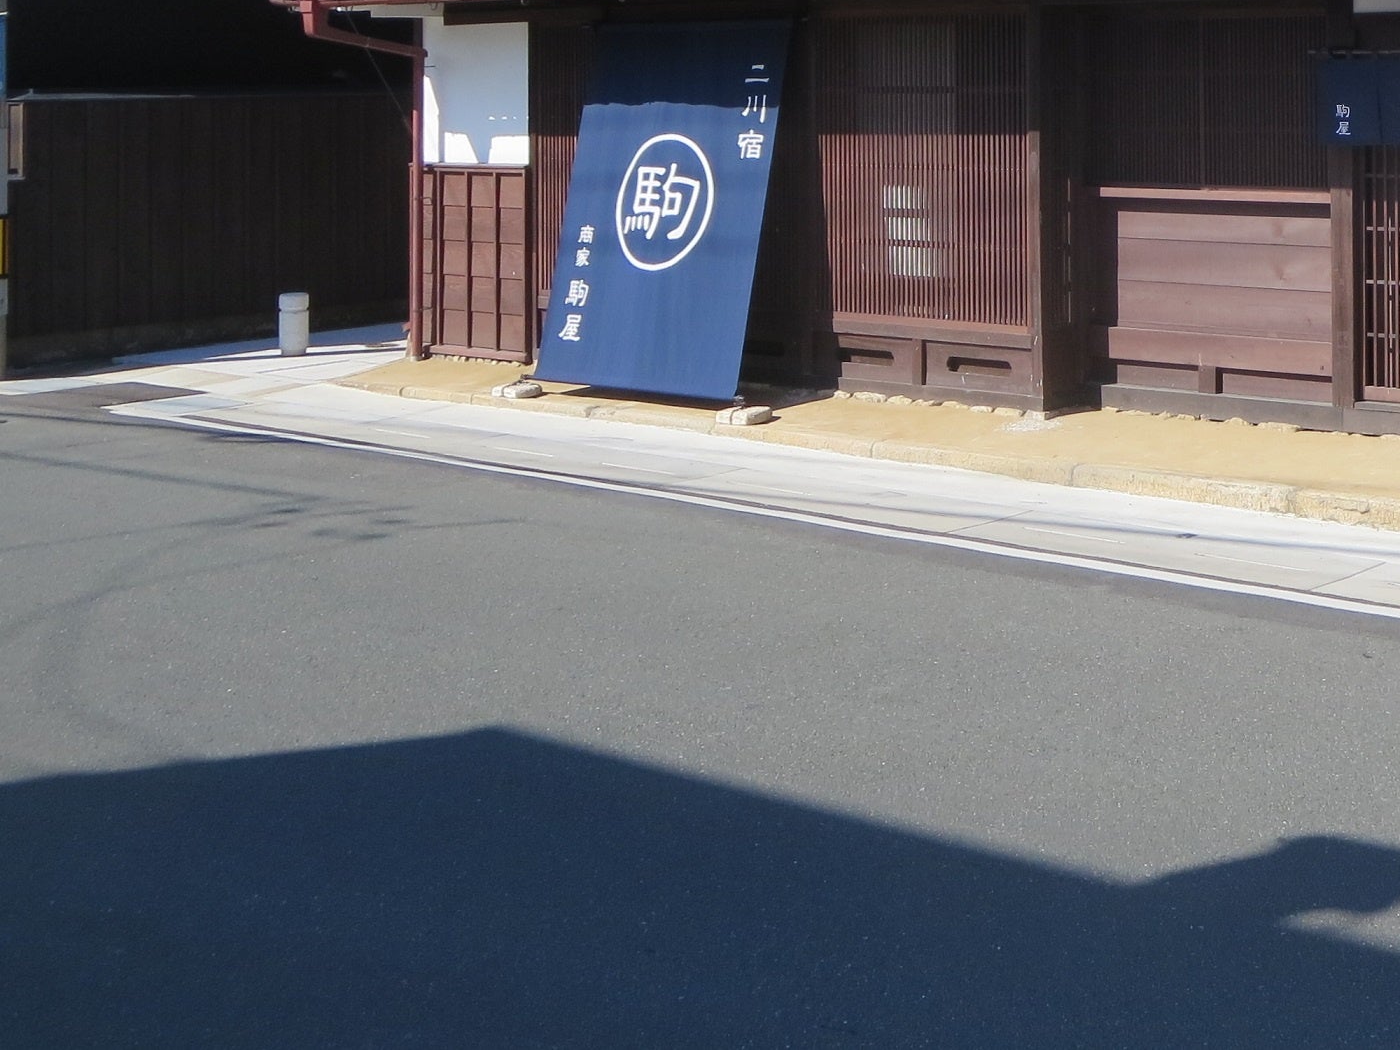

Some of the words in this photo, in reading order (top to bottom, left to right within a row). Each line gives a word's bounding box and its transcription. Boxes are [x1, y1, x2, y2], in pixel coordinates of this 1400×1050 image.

[737, 63, 770, 160] 二川宿
[1335, 103, 1352, 136] 駒屋
[623, 162, 702, 241] 駒
